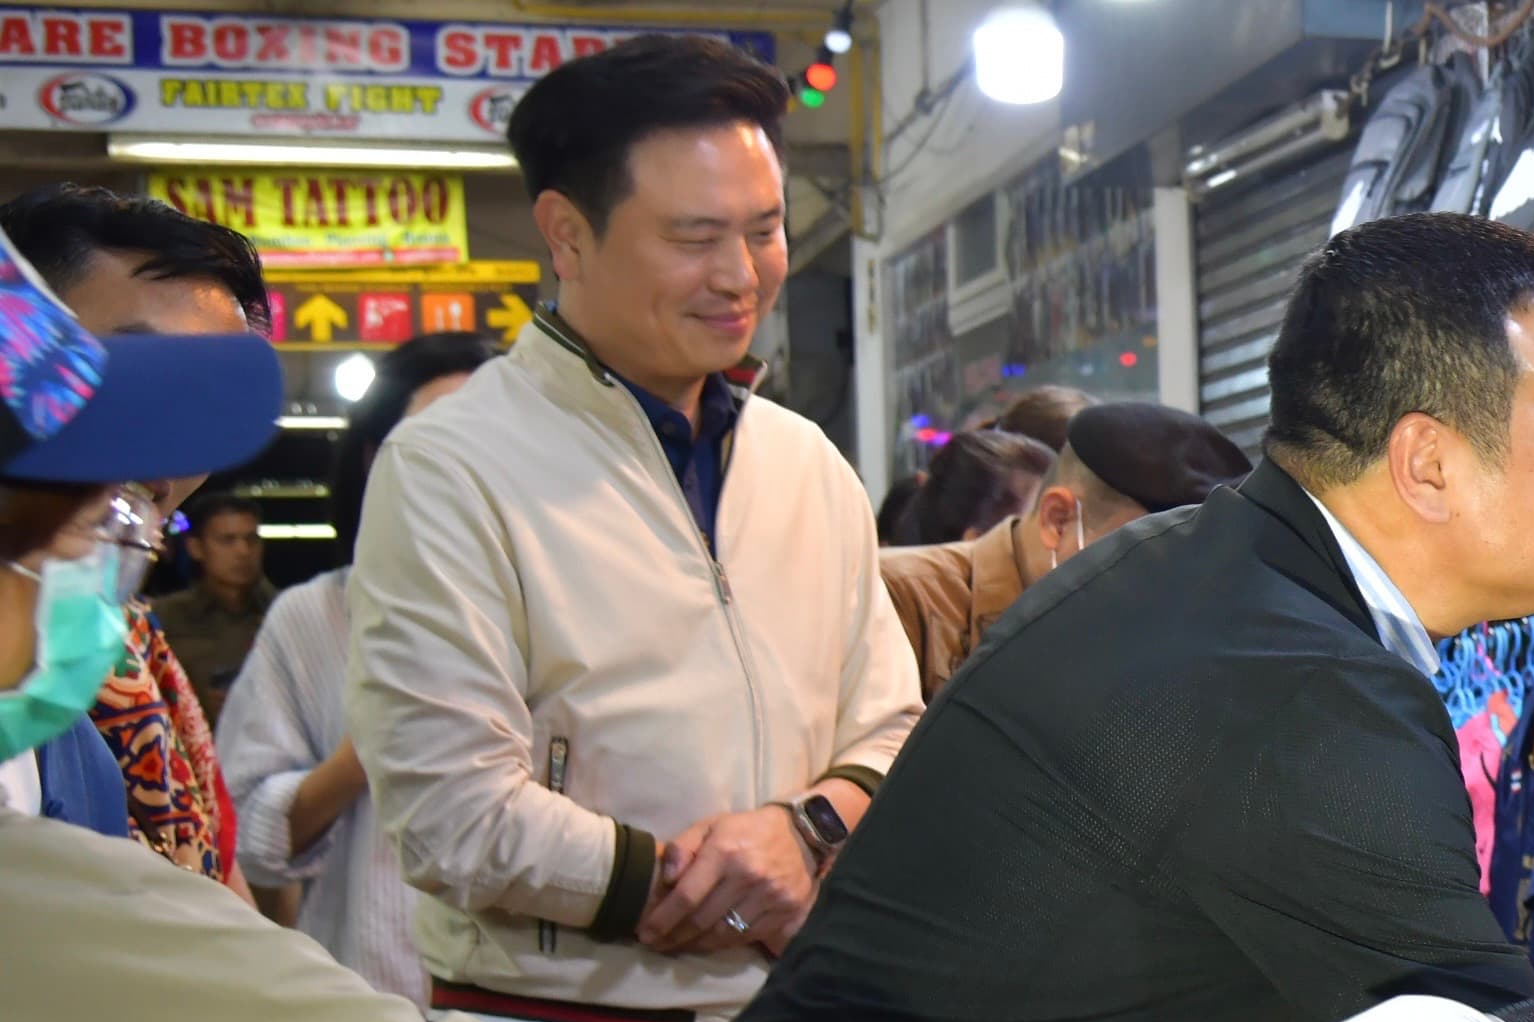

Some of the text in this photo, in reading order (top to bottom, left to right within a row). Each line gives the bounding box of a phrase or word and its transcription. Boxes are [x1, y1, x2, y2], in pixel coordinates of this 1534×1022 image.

[168, 22, 403, 66] BOXING
[324, 84, 443, 116] FIGHT
[166, 177, 449, 228] SAM TATTOO
